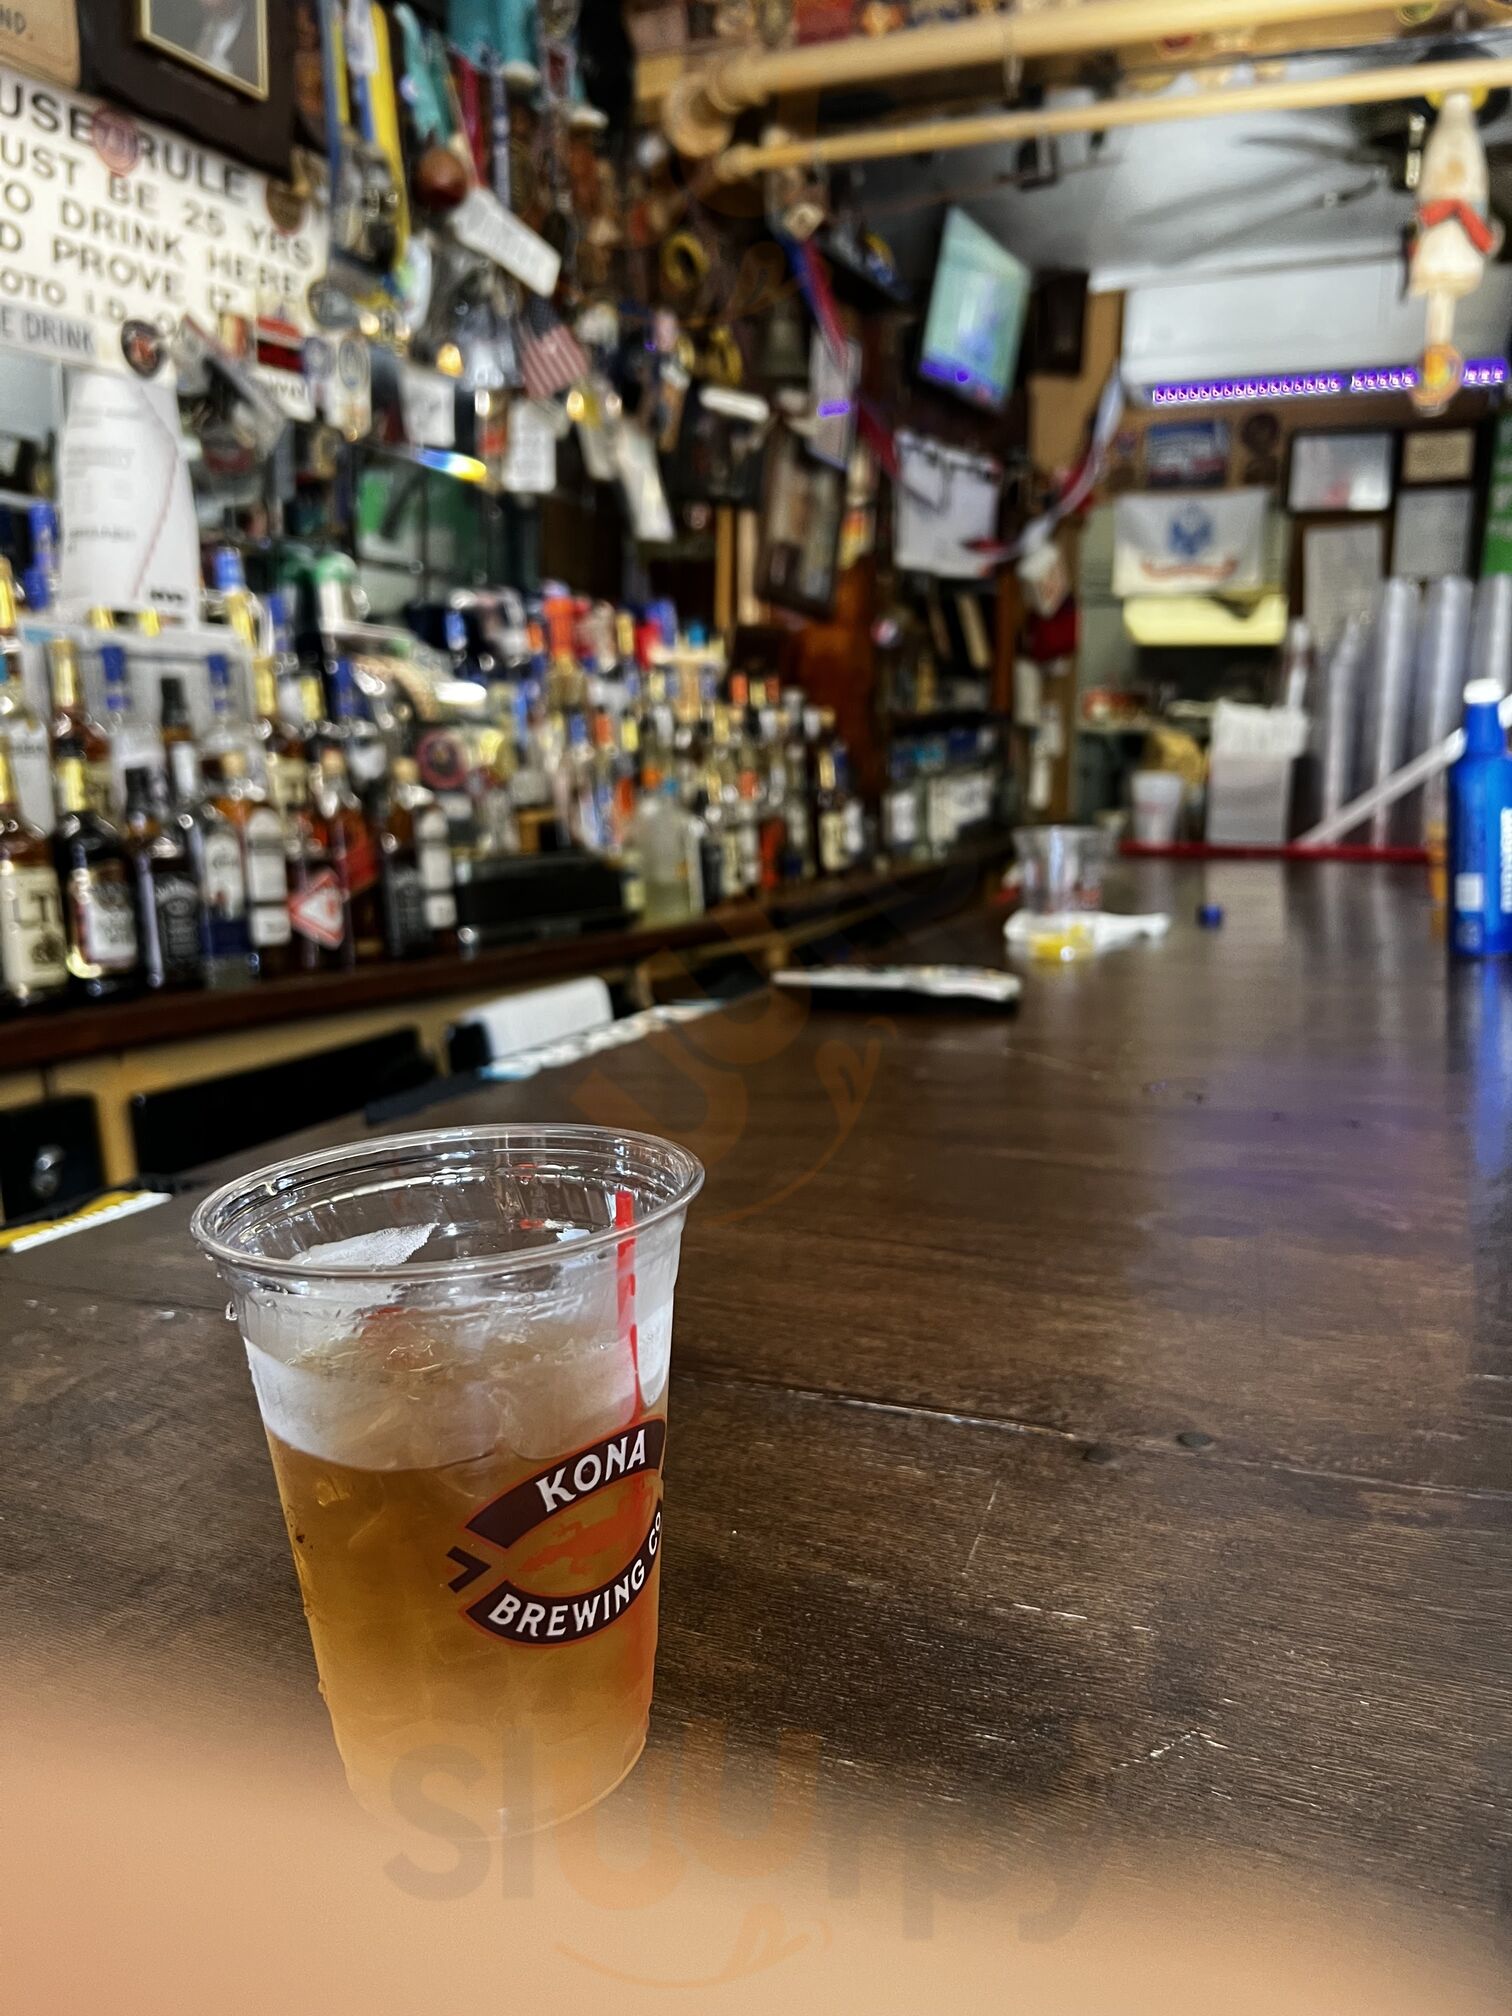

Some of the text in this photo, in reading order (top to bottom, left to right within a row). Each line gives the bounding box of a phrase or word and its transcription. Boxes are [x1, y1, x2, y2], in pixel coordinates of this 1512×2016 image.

[109, 173, 158, 217] BE
[54, 233, 184, 303] PROVE
[61, 198, 184, 265] DRINK
[206, 245, 299, 297] HERE
[25, 310, 96, 353] DRINK
[536, 1429, 647, 1512] KONA
[488, 1558, 646, 1638] BREWING
